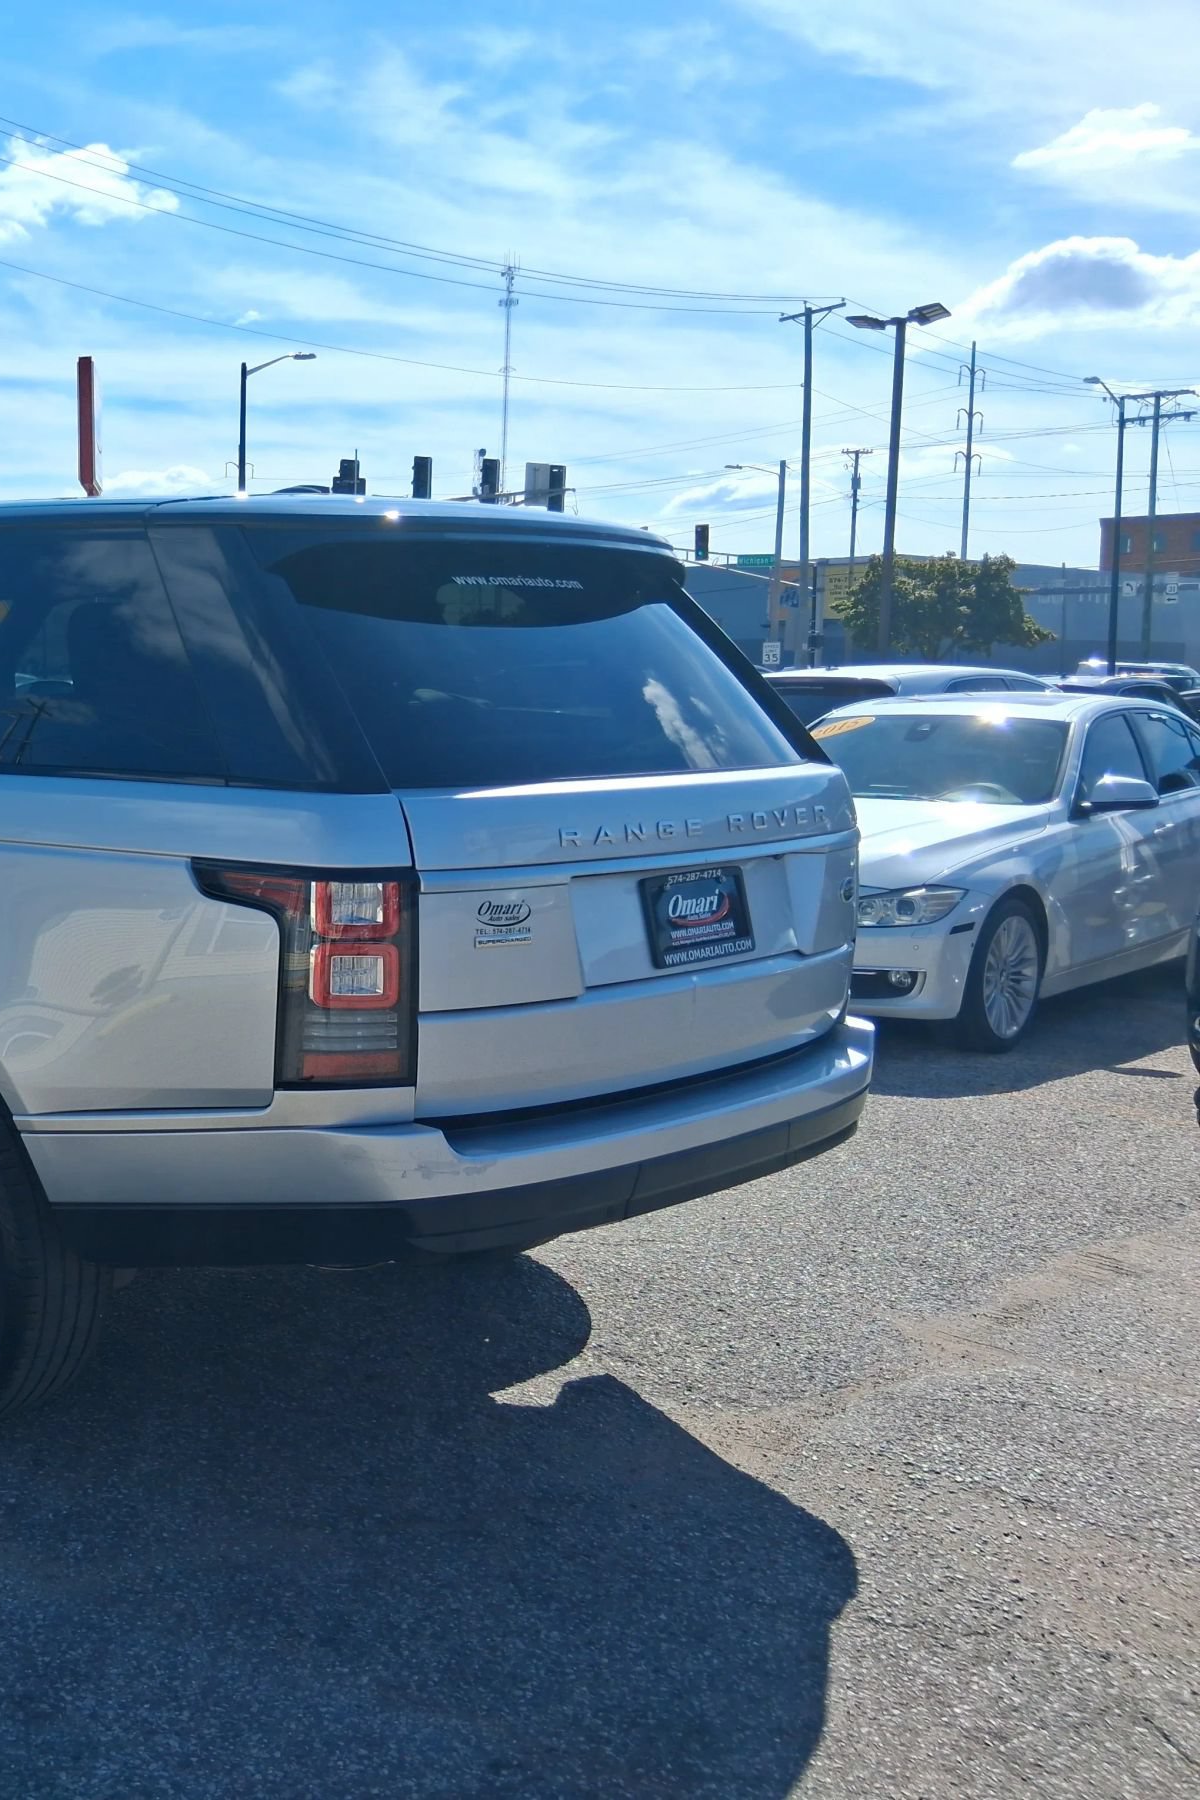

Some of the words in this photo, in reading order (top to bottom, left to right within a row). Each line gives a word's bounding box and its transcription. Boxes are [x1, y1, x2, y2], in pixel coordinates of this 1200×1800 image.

[452, 575, 584, 590] www.omariauto.com
[764, 653, 779, 663] 35
[559, 818, 704, 848] RANGE
[726, 804, 826, 833] ROVER
[668, 868, 722, 885] 574-287-4714
[477, 899, 525, 916] Omari
[668, 888, 719, 918] Omari
[492, 926, 531, 935] 574-287-4714
[670, 921, 735, 940] WWW.OMARIAUTO.COM
[664, 939, 753, 966] WWW.OMARIAUTO.COM
